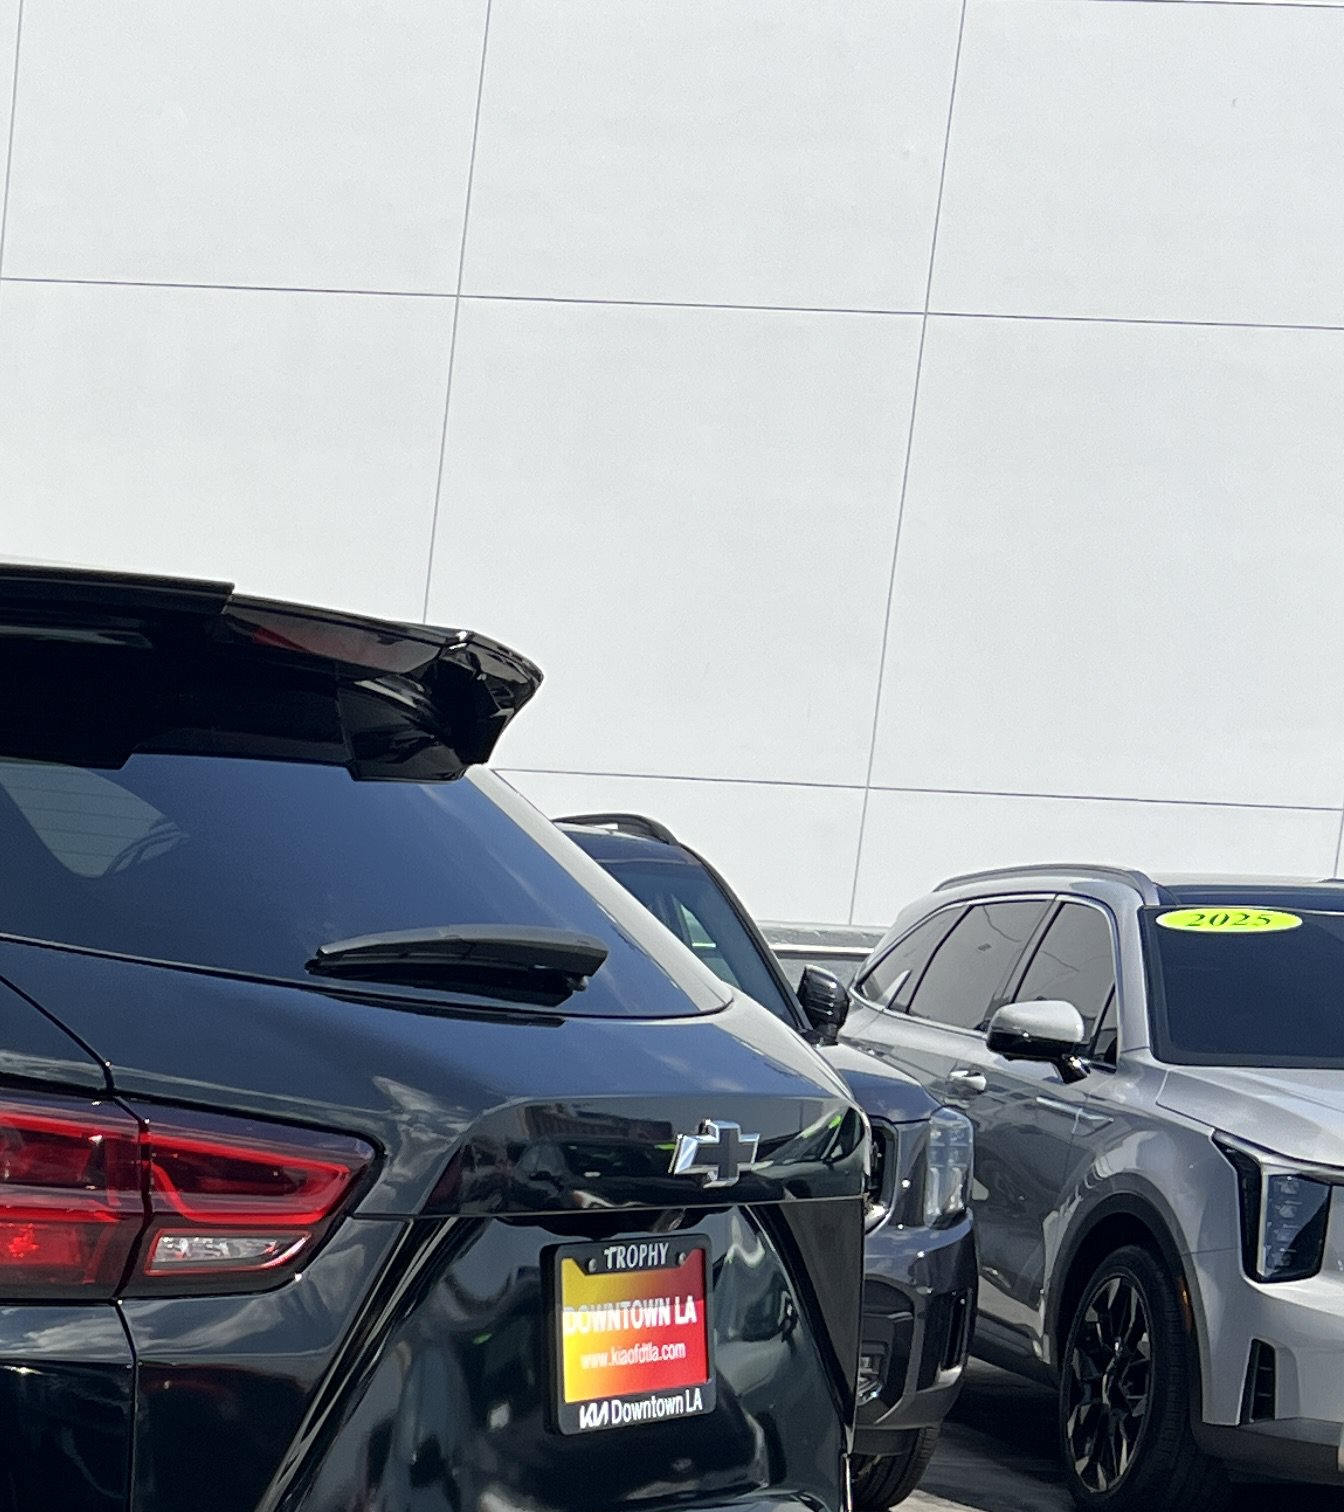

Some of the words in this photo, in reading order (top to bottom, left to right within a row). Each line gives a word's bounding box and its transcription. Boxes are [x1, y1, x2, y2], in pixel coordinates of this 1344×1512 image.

[1185, 912, 1273, 927] 2025
[603, 1242, 669, 1269] TROPHY
[563, 1297, 671, 1335] DOWNTOWN
[674, 1295, 697, 1325] LA
[611, 1394, 685, 1425] Downtown
[685, 1387, 703, 1412] LA
